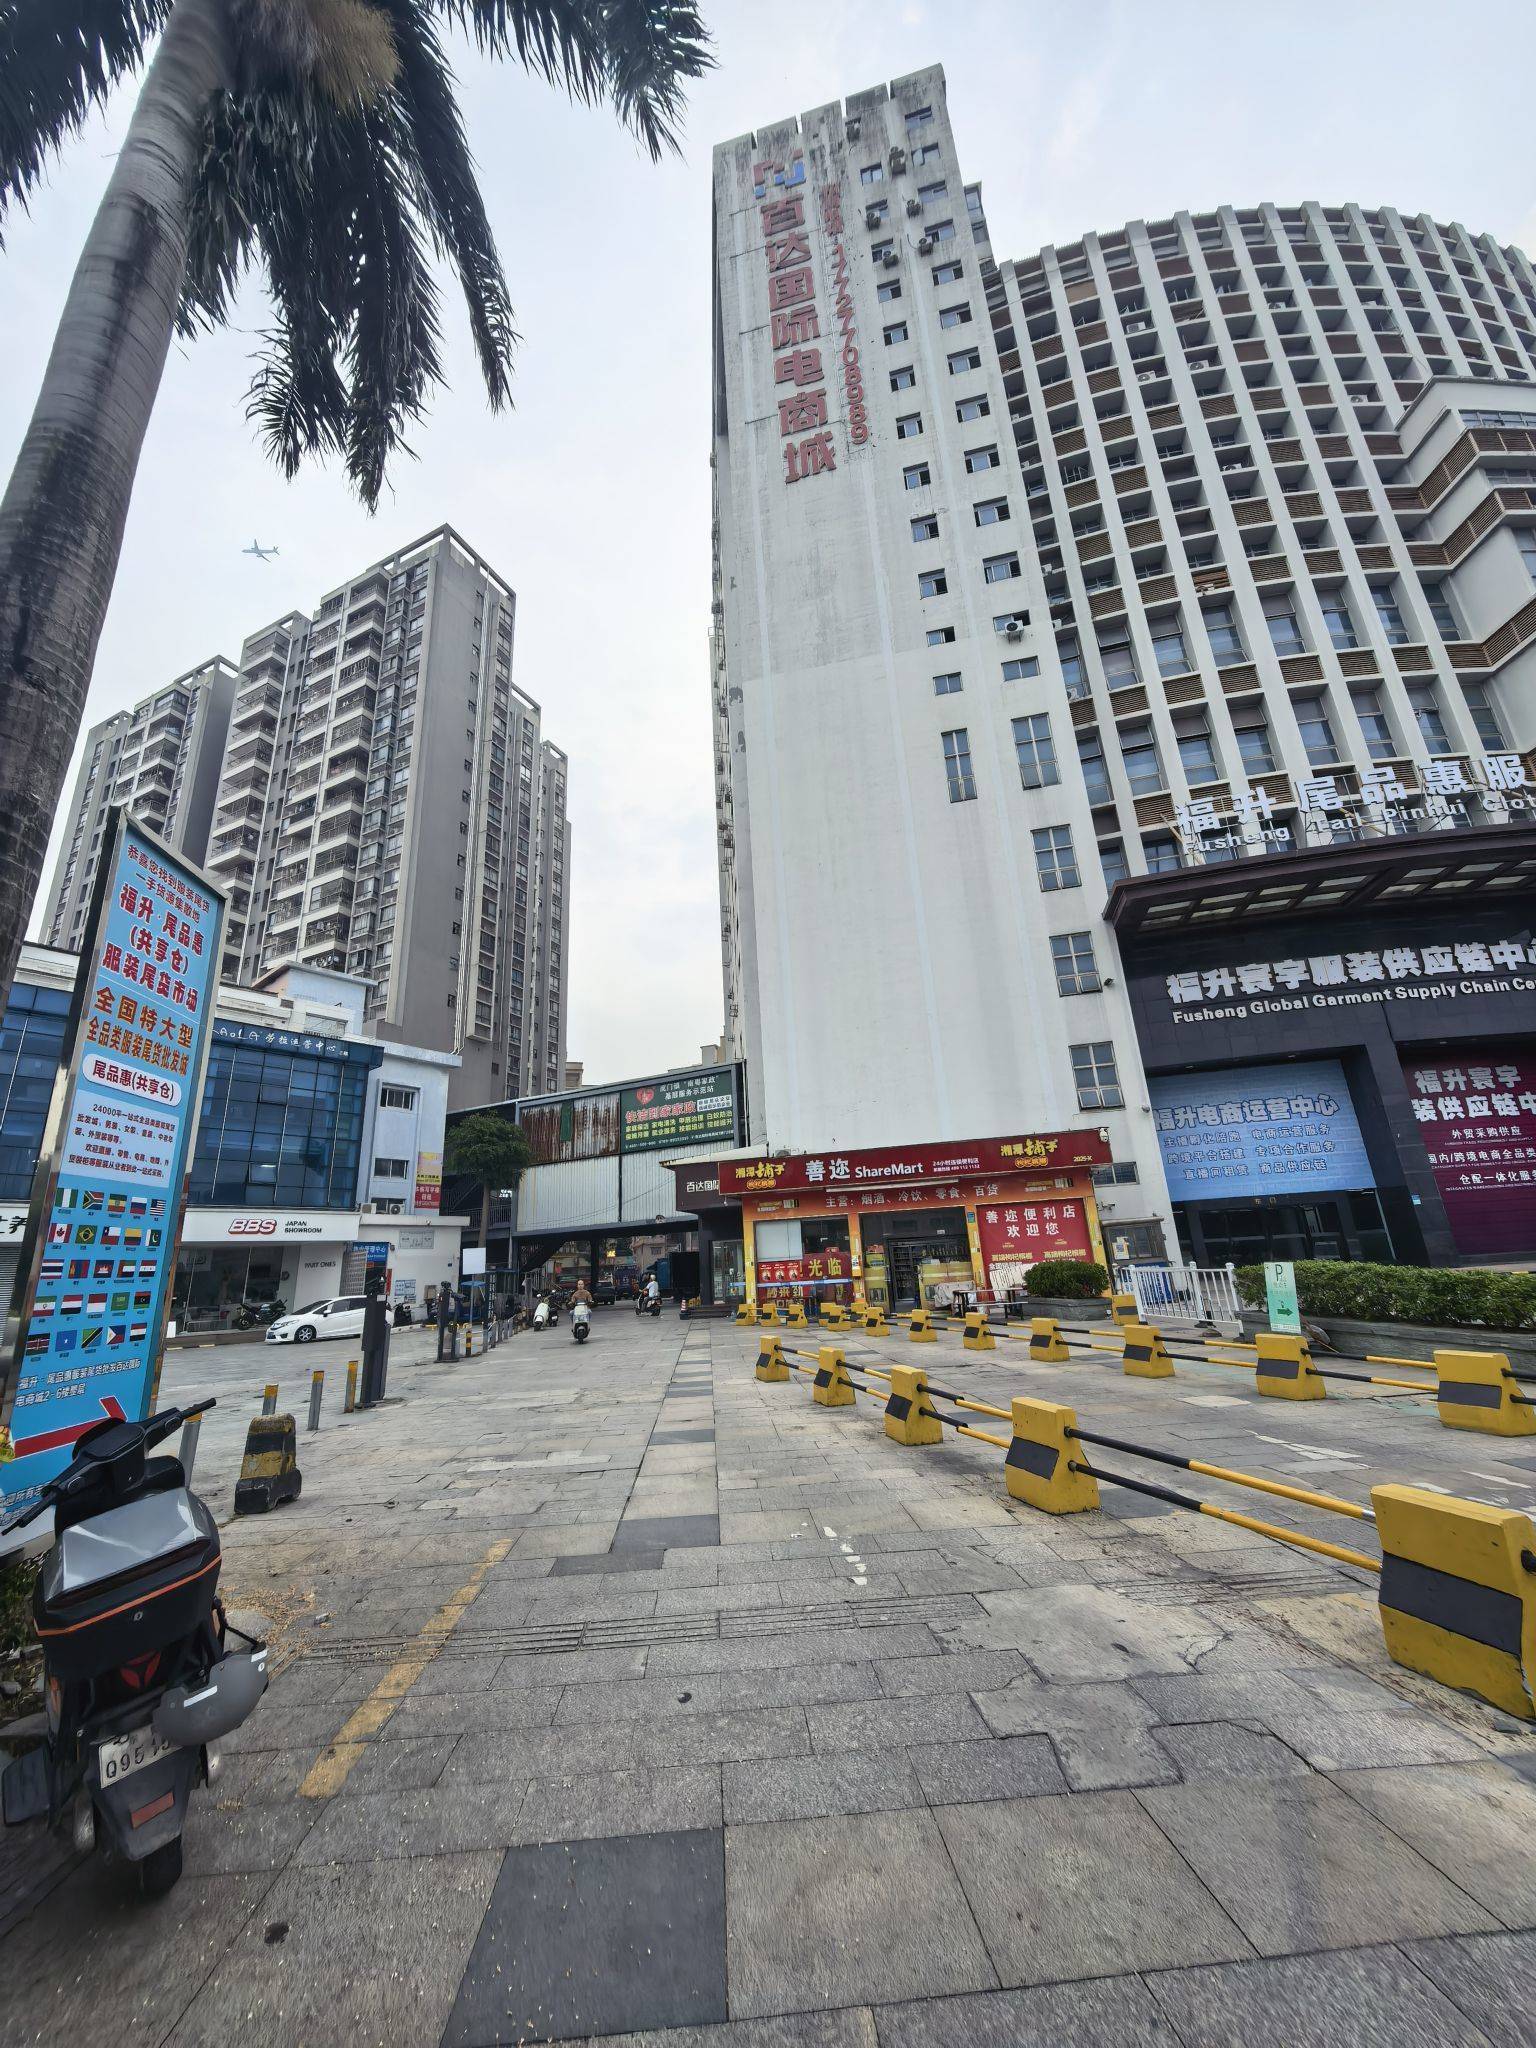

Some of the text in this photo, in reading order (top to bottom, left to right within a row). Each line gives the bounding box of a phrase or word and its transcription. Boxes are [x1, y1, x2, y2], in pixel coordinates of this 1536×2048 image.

[760, 192, 837, 484] 百达国际电商城
[1184, 827, 1290, 854] Fusheng
[1383, 799, 1465, 821] Pinhui
[120, 883, 204, 956] 福升·尾品惠
[102, 942, 198, 1012] 服装尾货市场
[1173, 1004, 1248, 1024] Fusheng
[1250, 995, 1309, 1015] Global
[1312, 988, 1391, 1008] Garment
[1394, 982, 1457, 1001] Supply
[1460, 978, 1509, 995] Chain
[94, 987, 193, 1048] 全国特大型
[92, 1059, 174, 1101] 尾品惠(共享仓)
[1414, 1065, 1521, 1094] 福升寰宇
[1154, 1093, 1340, 1131] 福升电商运营中心
[1252, 1123, 1330, 1141] 电商运营服务
[1451, 1125, 1522, 1140] 外贸采购供应
[1255, 1140, 1336, 1158] 专项合作服务
[855, 1161, 924, 1178] ShareMart
[1259, 1158, 1327, 1175] 商品供应链
[985, 1204, 1076, 1224] 善迩便利店
[228, 1219, 277, 1235] BBS
[1006, 1221, 1060, 1238] 欢迎您
[808, 1258, 842, 1277] 光临
[1275, 1264, 1283, 1281] P
